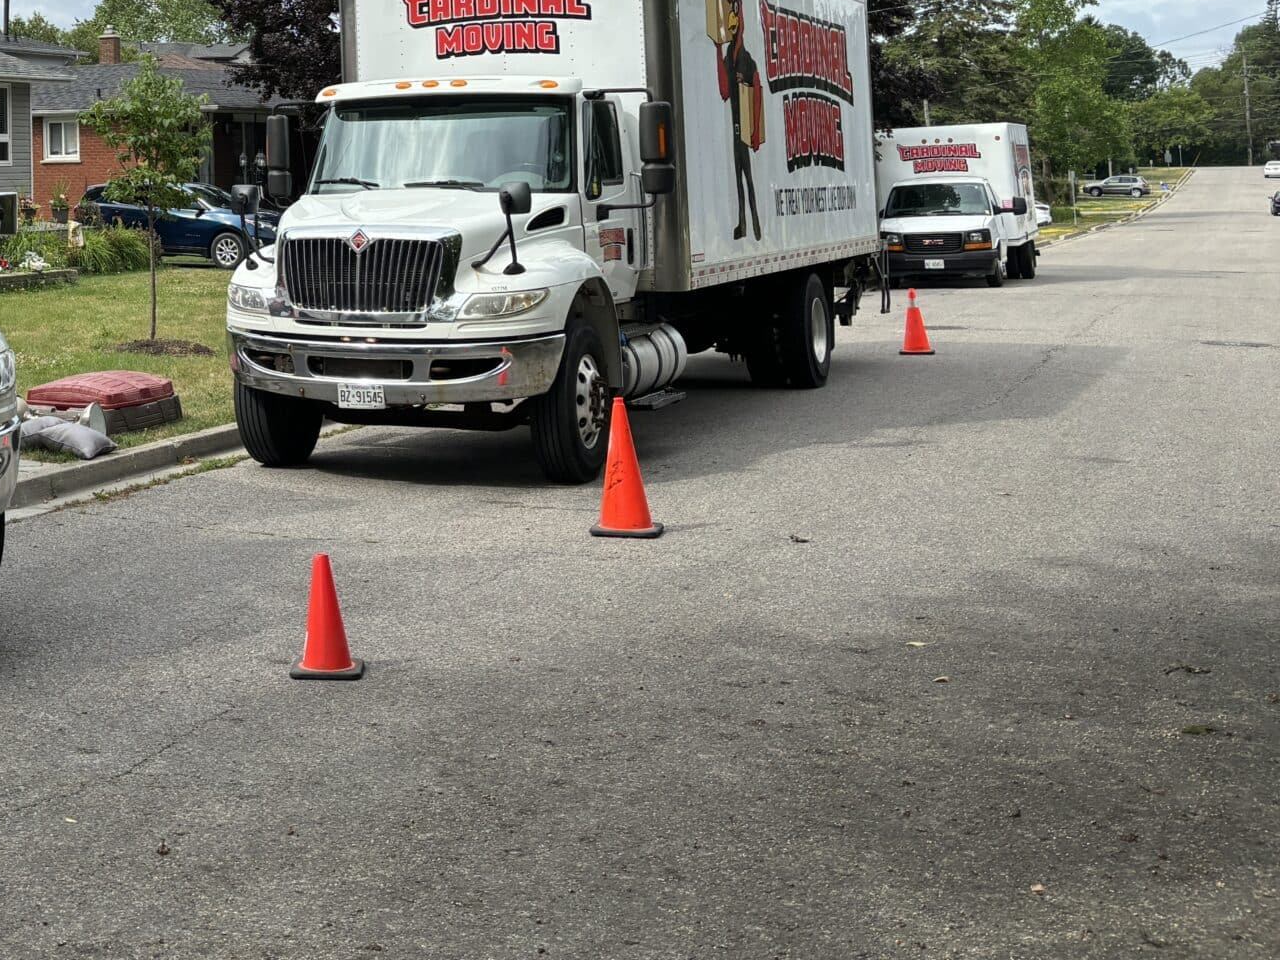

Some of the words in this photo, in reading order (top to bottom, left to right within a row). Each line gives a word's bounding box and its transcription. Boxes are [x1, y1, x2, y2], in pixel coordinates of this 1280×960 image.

[436, 21, 560, 58] MOVING
[783, 92, 844, 172] MOVING
[897, 144, 981, 161] CARDINAL
[913, 159, 968, 173] MOVING
